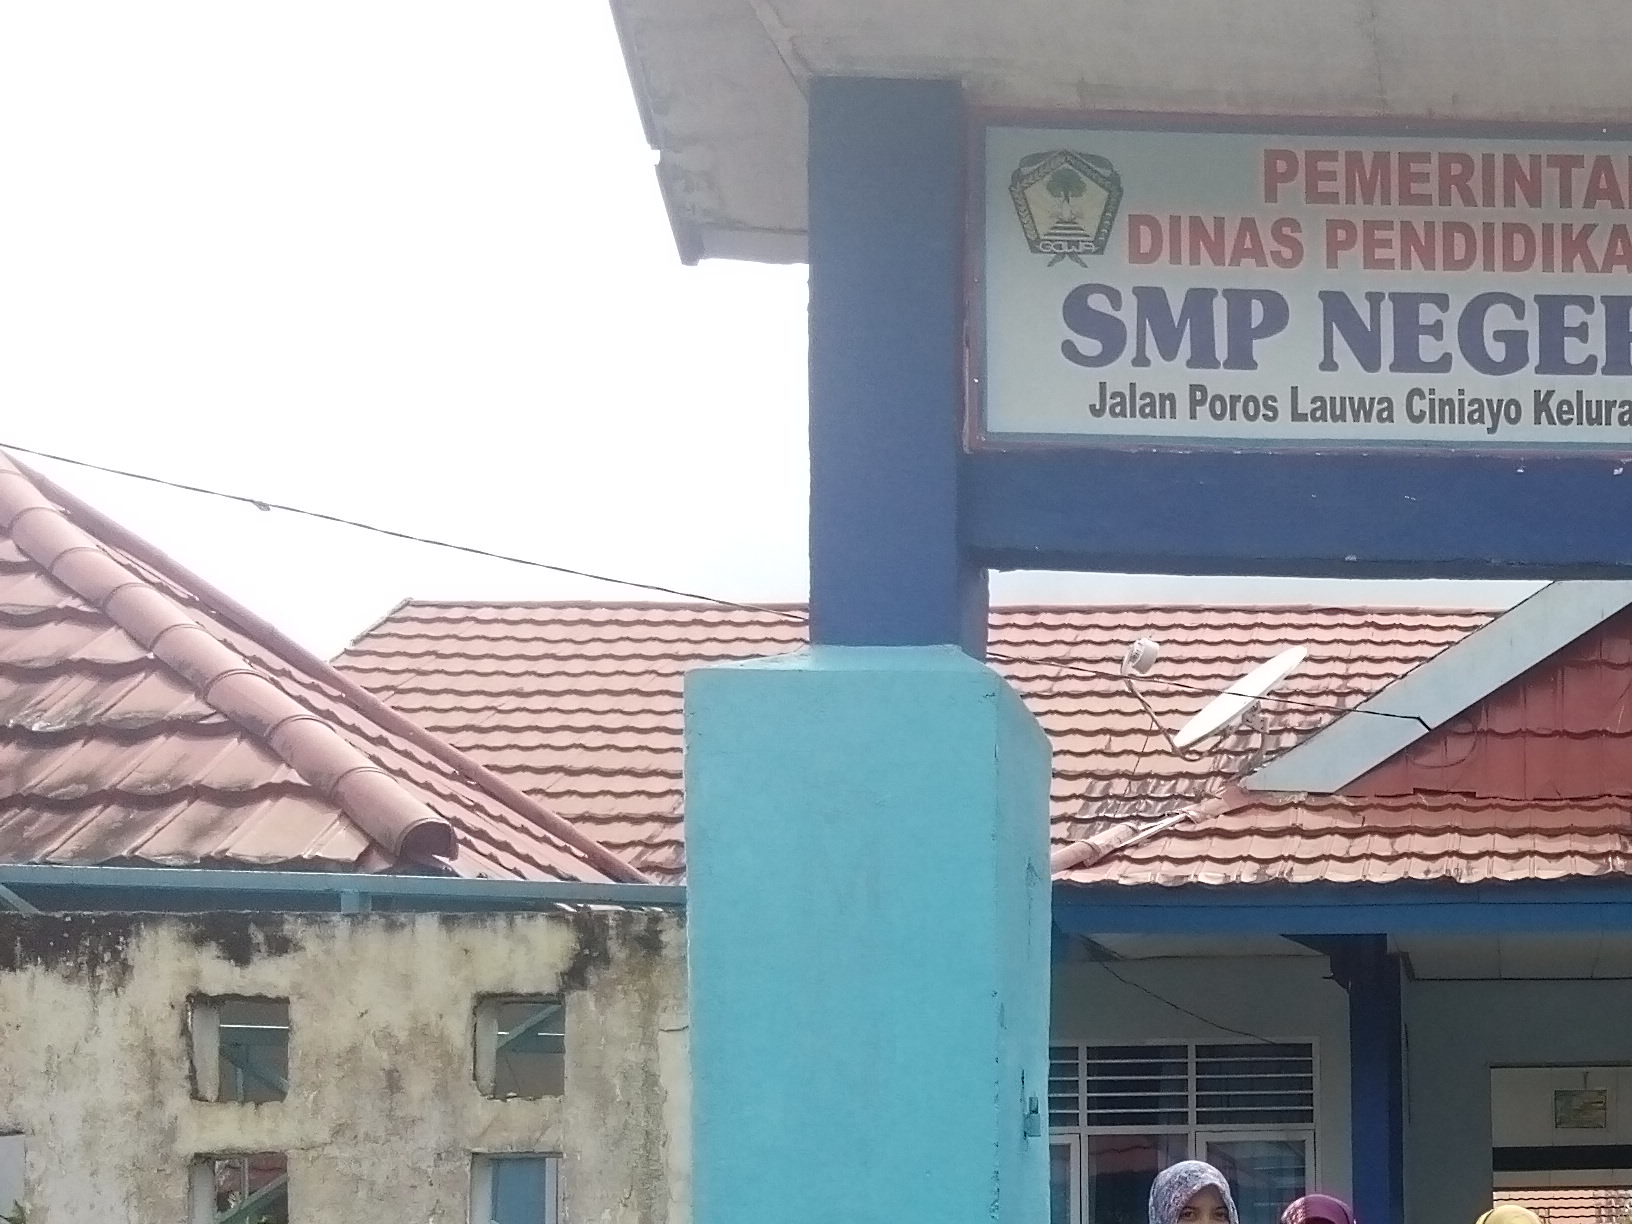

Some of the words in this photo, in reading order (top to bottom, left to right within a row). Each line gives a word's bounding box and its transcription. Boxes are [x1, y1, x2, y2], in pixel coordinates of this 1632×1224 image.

[1128, 214, 1304, 268] DINAS
[1061, 283, 1289, 370] SMP
[1089, 382, 1176, 419] Jalan
[1189, 385, 1278, 422] Poros
[1291, 386, 1394, 423] Lauwa
[1406, 387, 1522, 435] Ciniayo
